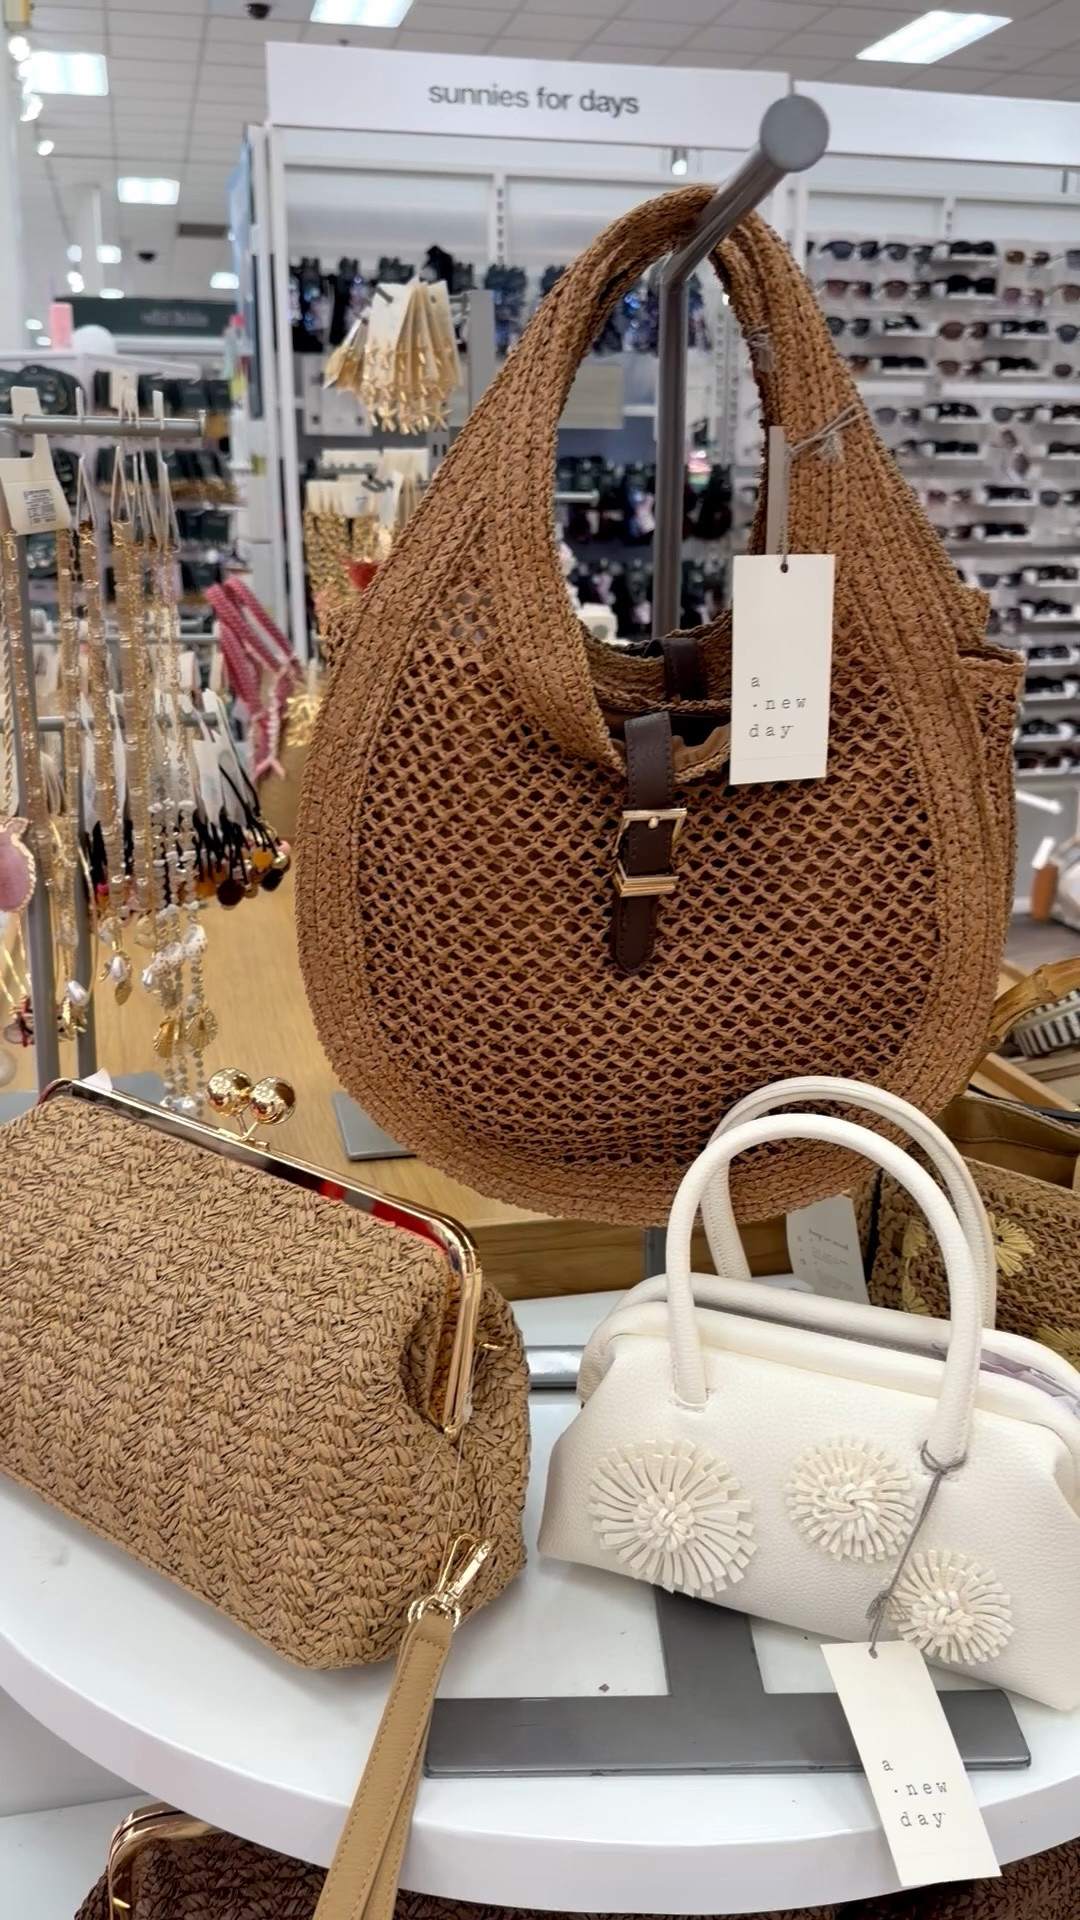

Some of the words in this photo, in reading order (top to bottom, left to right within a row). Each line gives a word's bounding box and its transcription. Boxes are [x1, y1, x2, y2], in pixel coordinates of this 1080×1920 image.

[428, 83, 529, 108] sunnies
[536, 86, 573, 110] for
[579, 89, 640, 118] days
[751, 676, 761, 688] a
[749, 723, 794, 739] day
[881, 1759, 894, 1772] a
[900, 1811, 946, 1828] day
